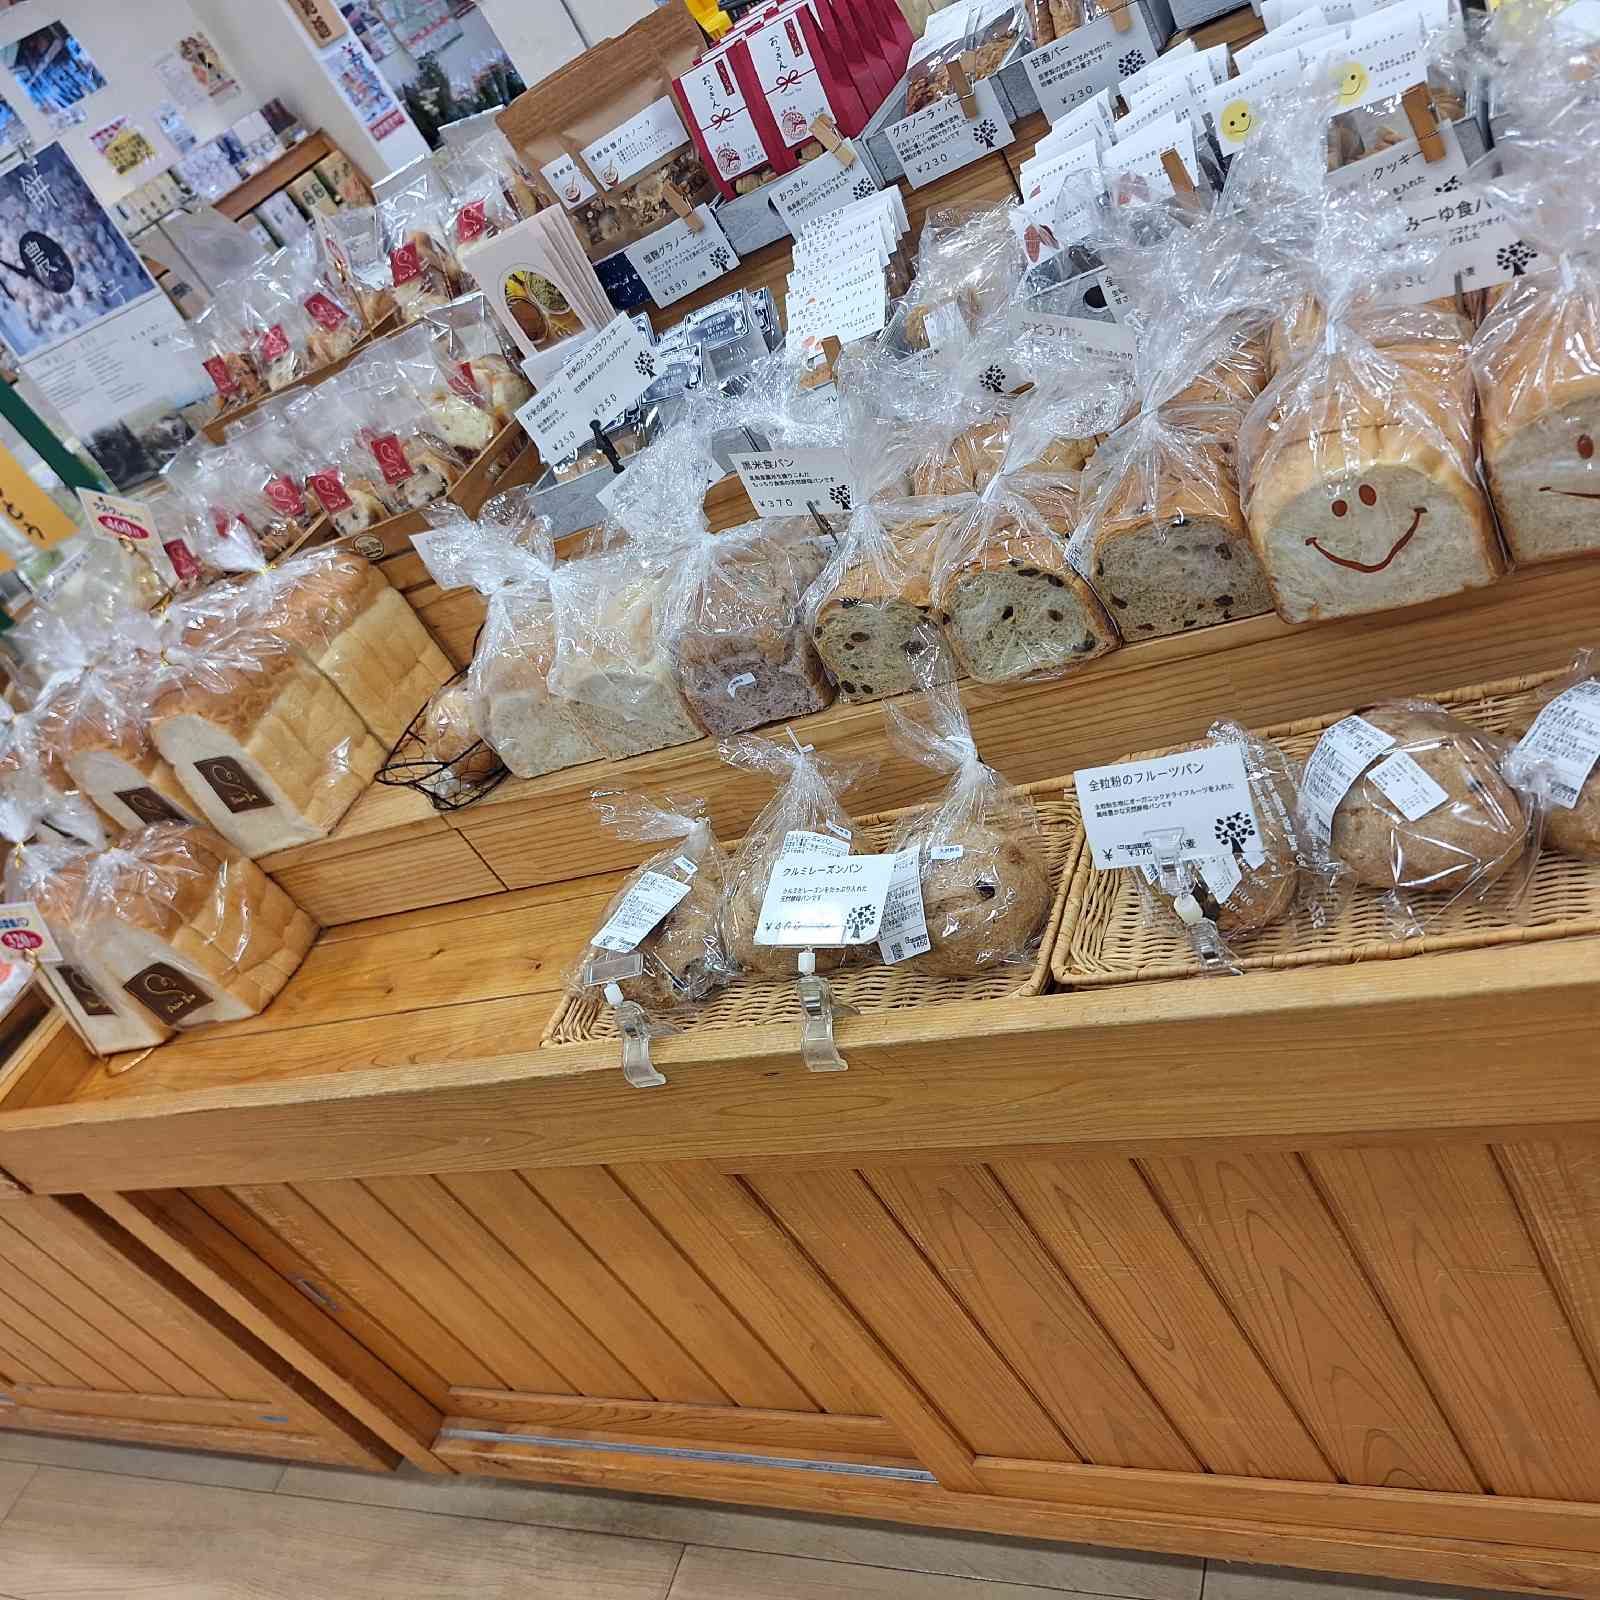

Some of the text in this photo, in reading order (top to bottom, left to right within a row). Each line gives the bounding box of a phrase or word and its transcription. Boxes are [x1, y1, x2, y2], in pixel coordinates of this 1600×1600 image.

[1029, 44, 1070, 69] 甘酒バー
[1060, 84, 1094, 106] ¥230
[891, 95, 962, 138] グラノーラ・バー
[915, 152, 949, 175] ¥230
[663, 279, 689, 298] ¥590
[592, 393, 618, 418] ¥250
[551, 430, 577, 452] ¥250
[740, 458, 795, 472] 黒米食パン
[757, 498, 794, 508] ¥370
[1088, 762, 1205, 792] 全粒粉のフルーツパン
[782, 863, 864, 880] クルミレーズンパン
